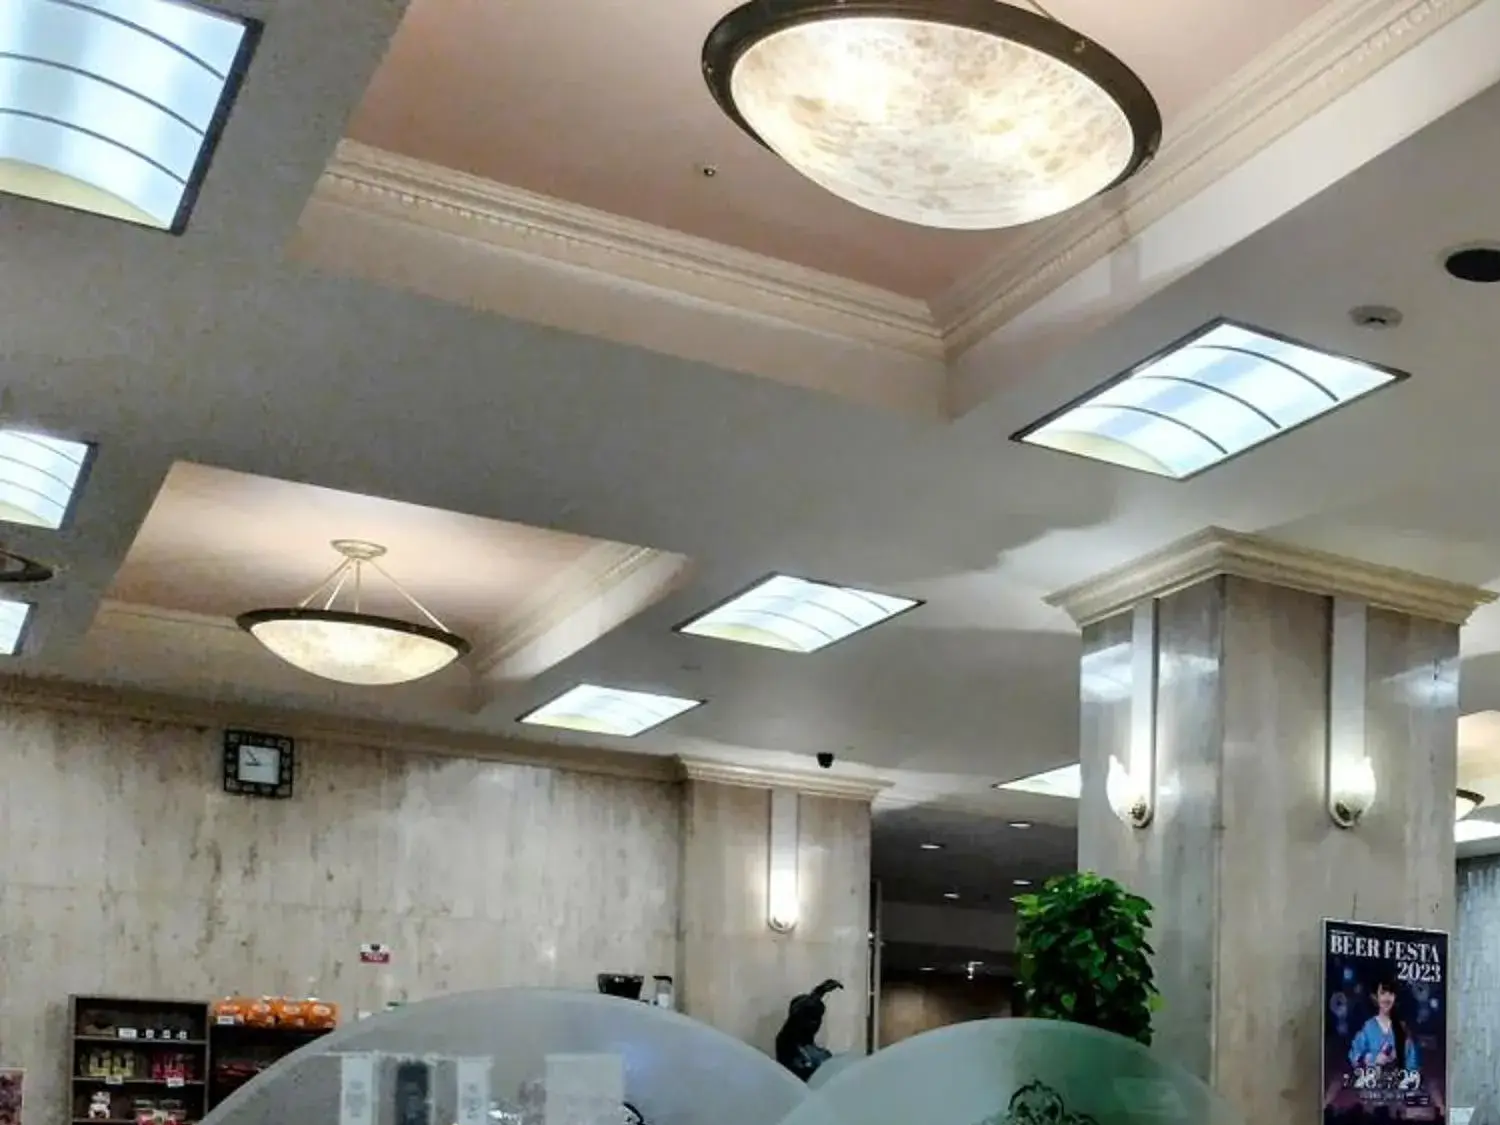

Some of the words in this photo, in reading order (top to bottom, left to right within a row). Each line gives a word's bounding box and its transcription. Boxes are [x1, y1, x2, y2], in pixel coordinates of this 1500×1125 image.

[1331, 935, 1380, 958] BEER
[1383, 939, 1440, 962] FESTA
[1397, 961, 1441, 982] 2023
